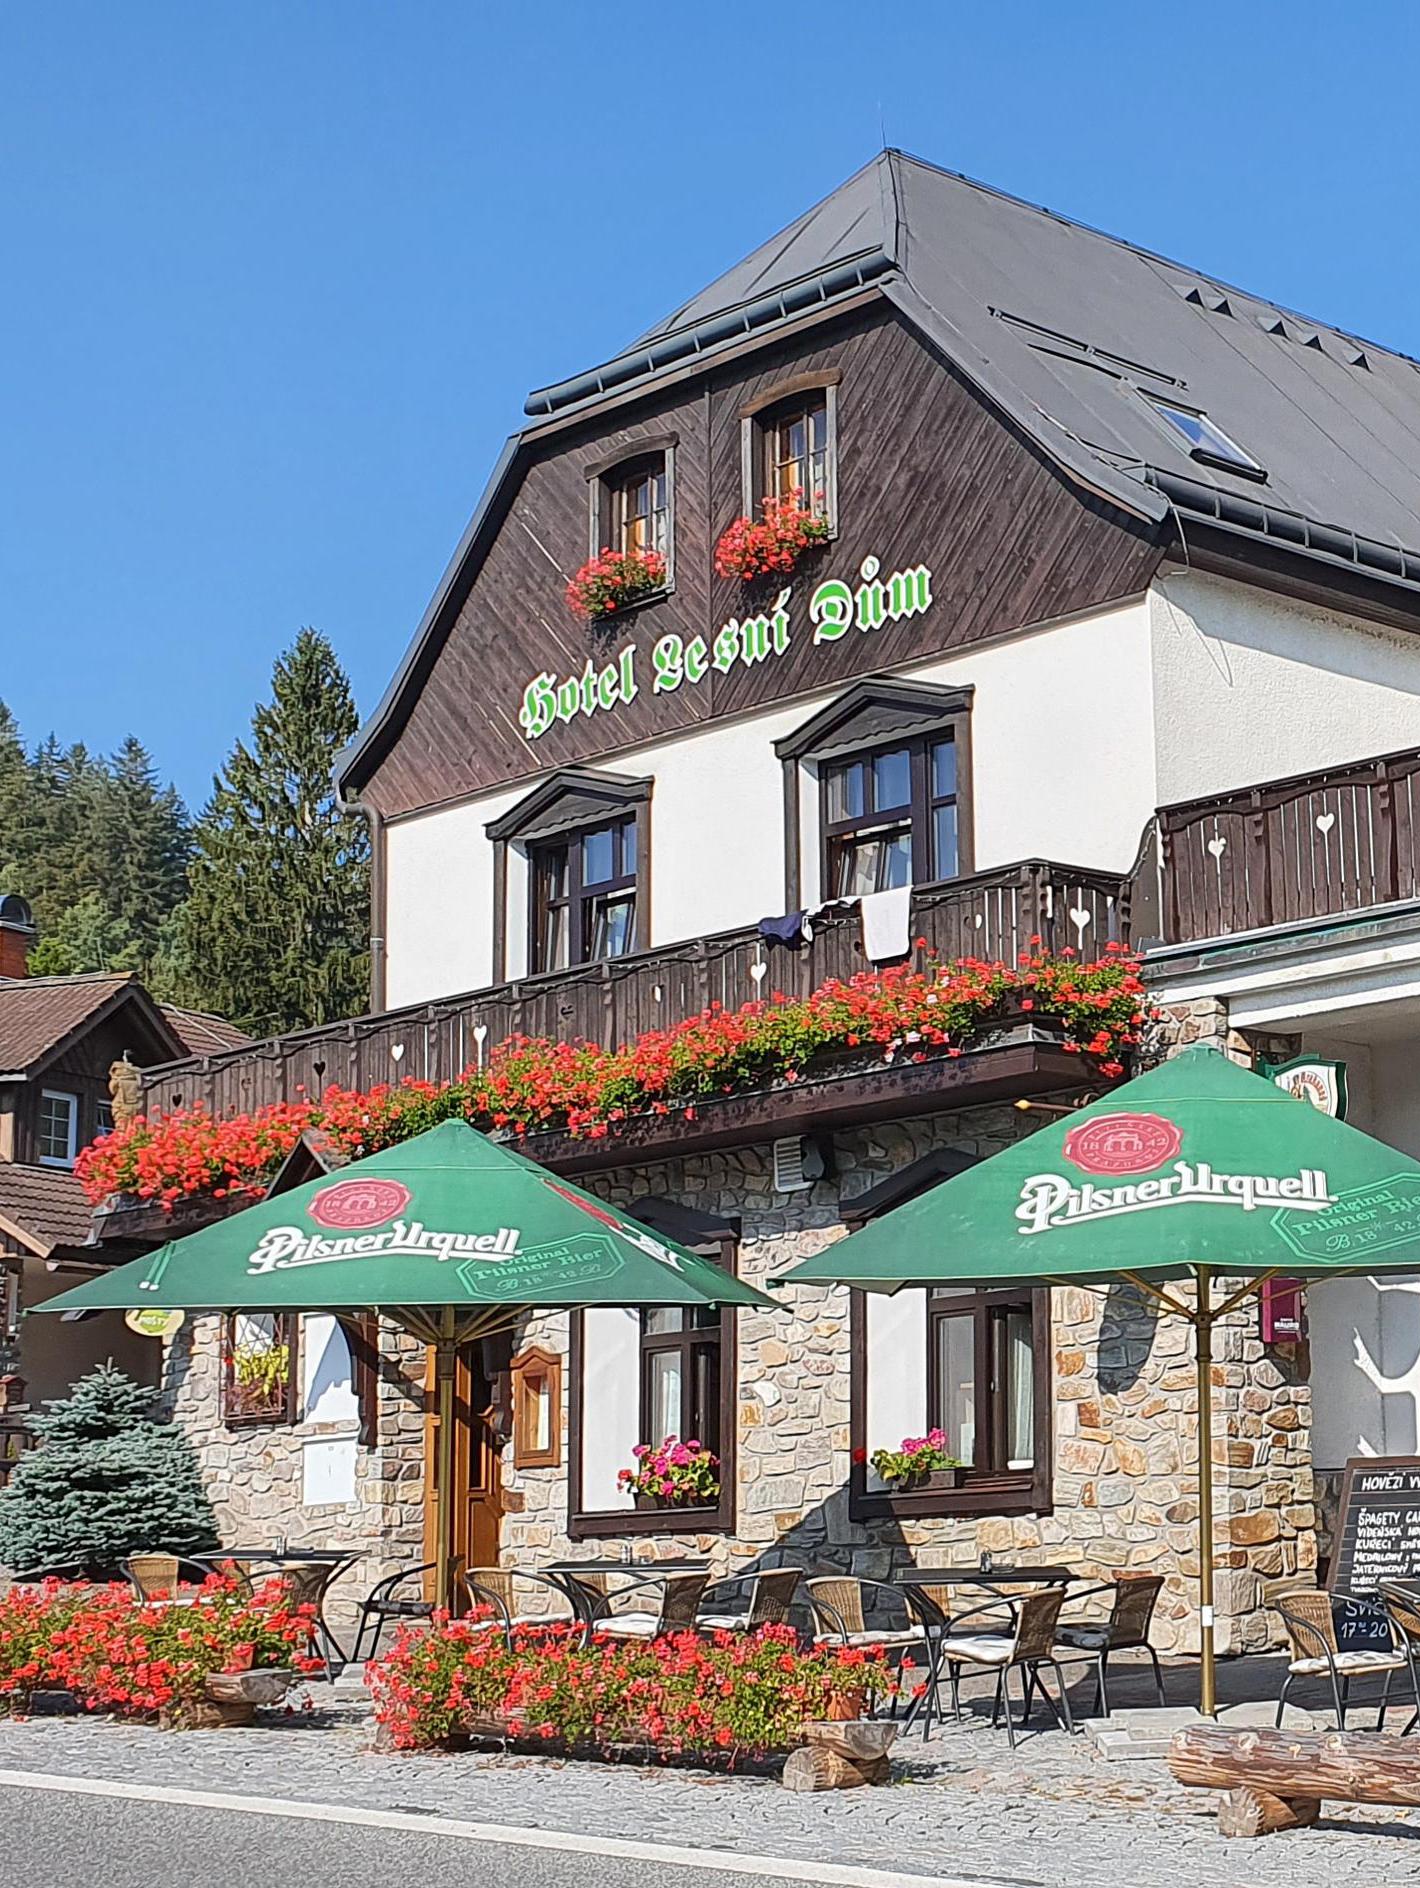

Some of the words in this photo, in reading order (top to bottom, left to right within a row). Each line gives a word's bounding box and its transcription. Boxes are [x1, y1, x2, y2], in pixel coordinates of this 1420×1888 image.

[519, 644, 640, 739] Hotel
[652, 586, 793, 694] Lesní
[809, 555, 934, 646] Dům
[1016, 1174, 1182, 1236] Pilsner
[1174, 1160, 1340, 1212] Urquell
[1317, 1190, 1395, 1217] Original
[1292, 1208, 1379, 1237] Pilsner
[1355, 1229, 1378, 1244] 18
[1393, 1220, 1416, 1233] 42
[246, 1225, 402, 1276] Pilsner
[392, 1219, 523, 1262] Urquell
[500, 1246, 570, 1267] Original
[473, 1258, 552, 1281] Pilsner
[557, 1248, 603, 1266] Bier
[1361, 1471, 1406, 1491] HOVĚZÍ
[1358, 1507, 1401, 1527] ŠPAGETY
